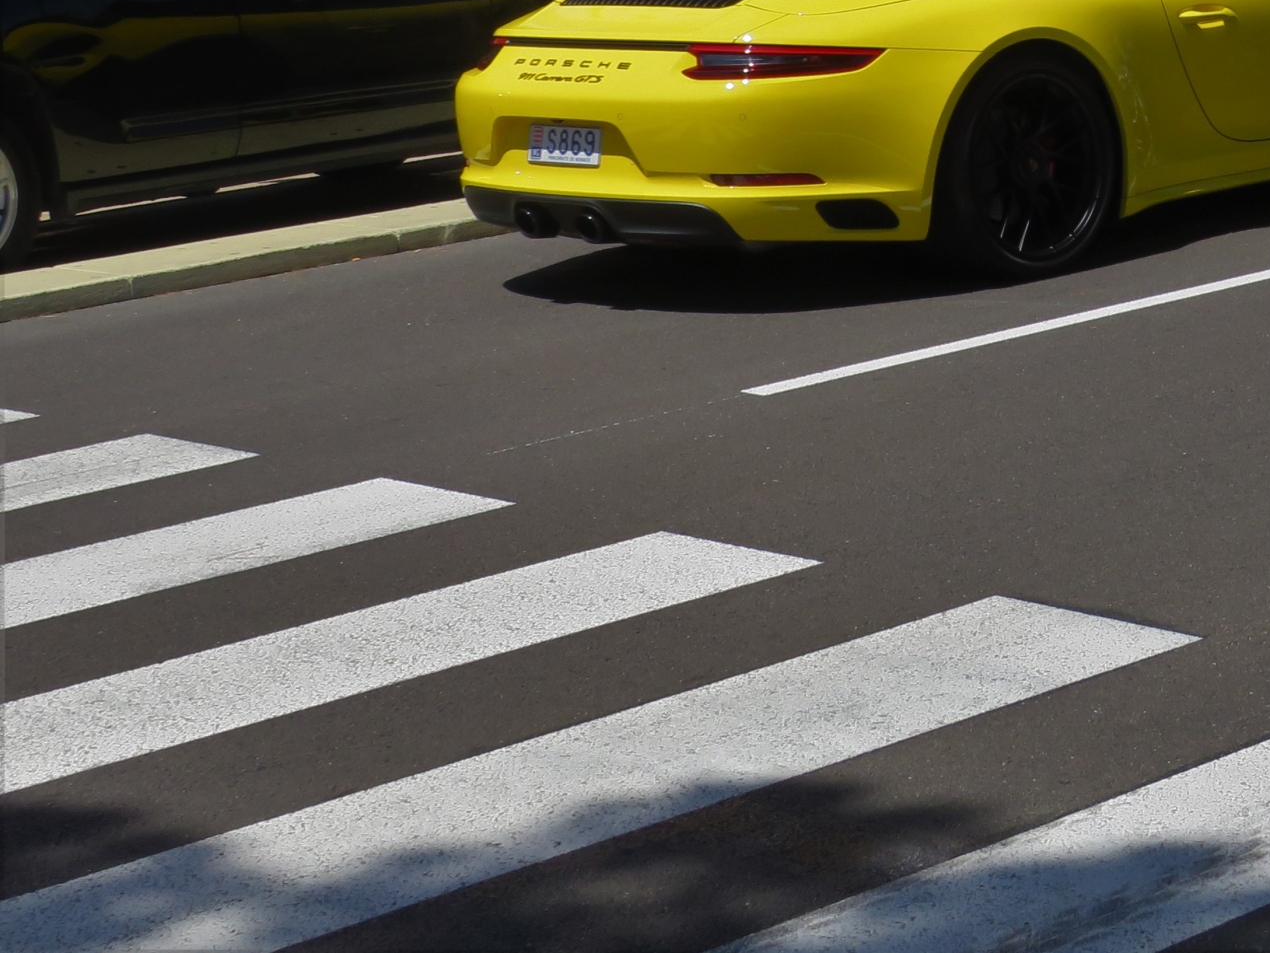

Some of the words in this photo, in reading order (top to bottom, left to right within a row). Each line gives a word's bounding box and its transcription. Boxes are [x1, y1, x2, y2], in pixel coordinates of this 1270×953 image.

[514, 58, 632, 70] PORSCHE
[535, 73, 572, 82] Carrera
[574, 75, 604, 84] GTS
[546, 129, 596, 156] S869
